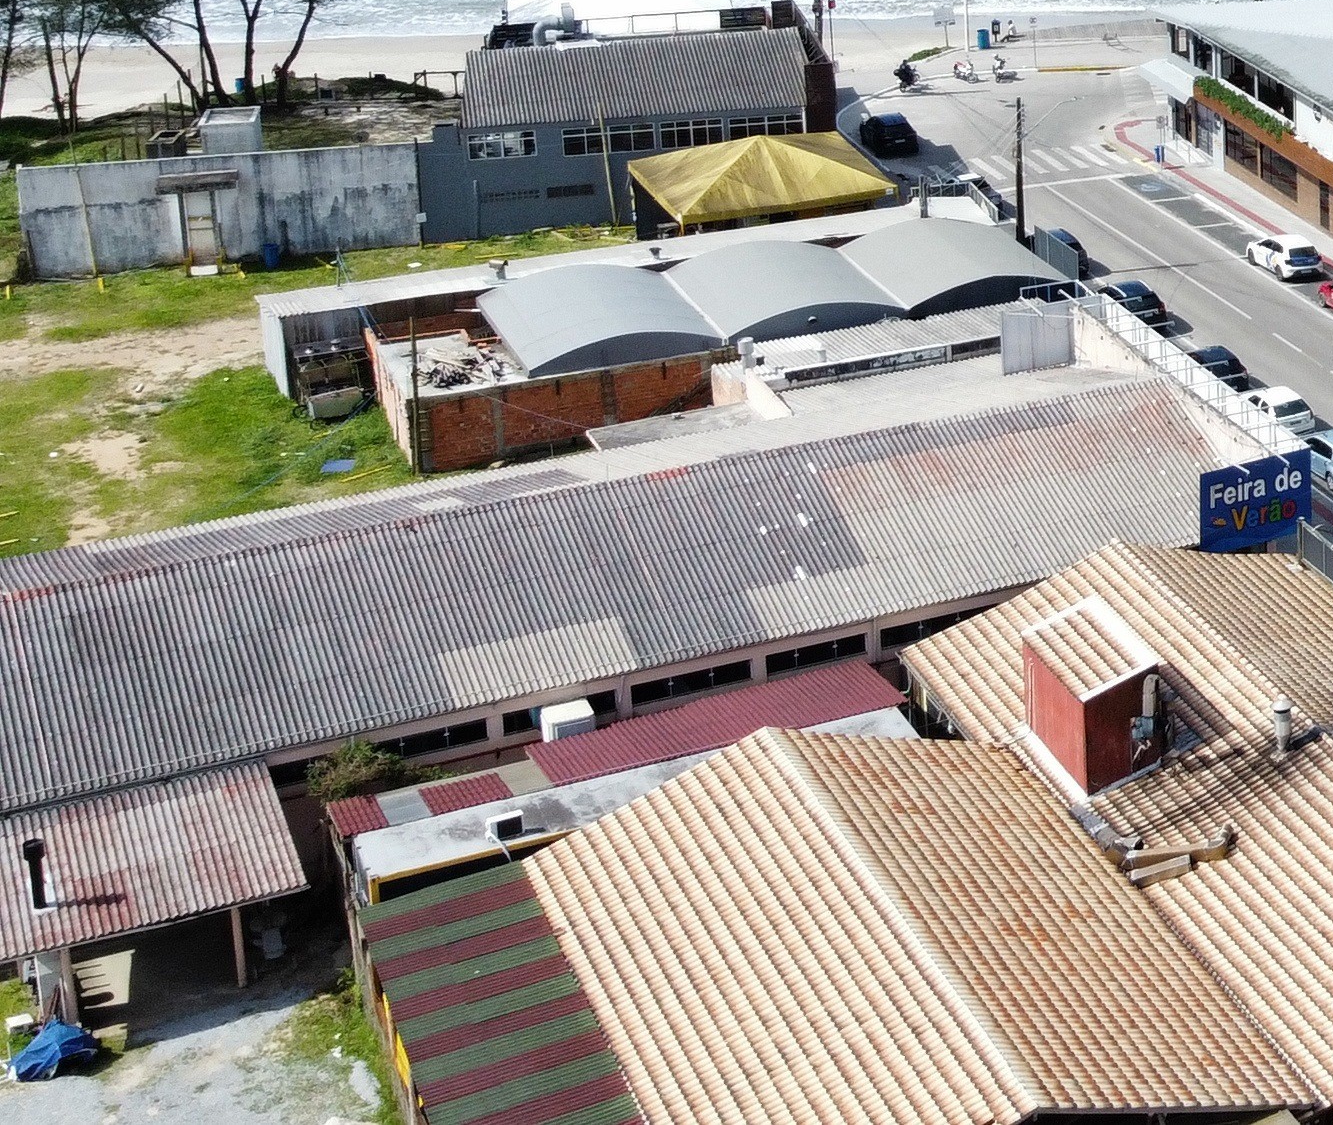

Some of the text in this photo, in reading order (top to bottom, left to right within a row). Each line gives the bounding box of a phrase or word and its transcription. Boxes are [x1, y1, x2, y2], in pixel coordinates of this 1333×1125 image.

[1209, 467, 1303, 509] Feira de
[1231, 497, 1297, 531] Verão
